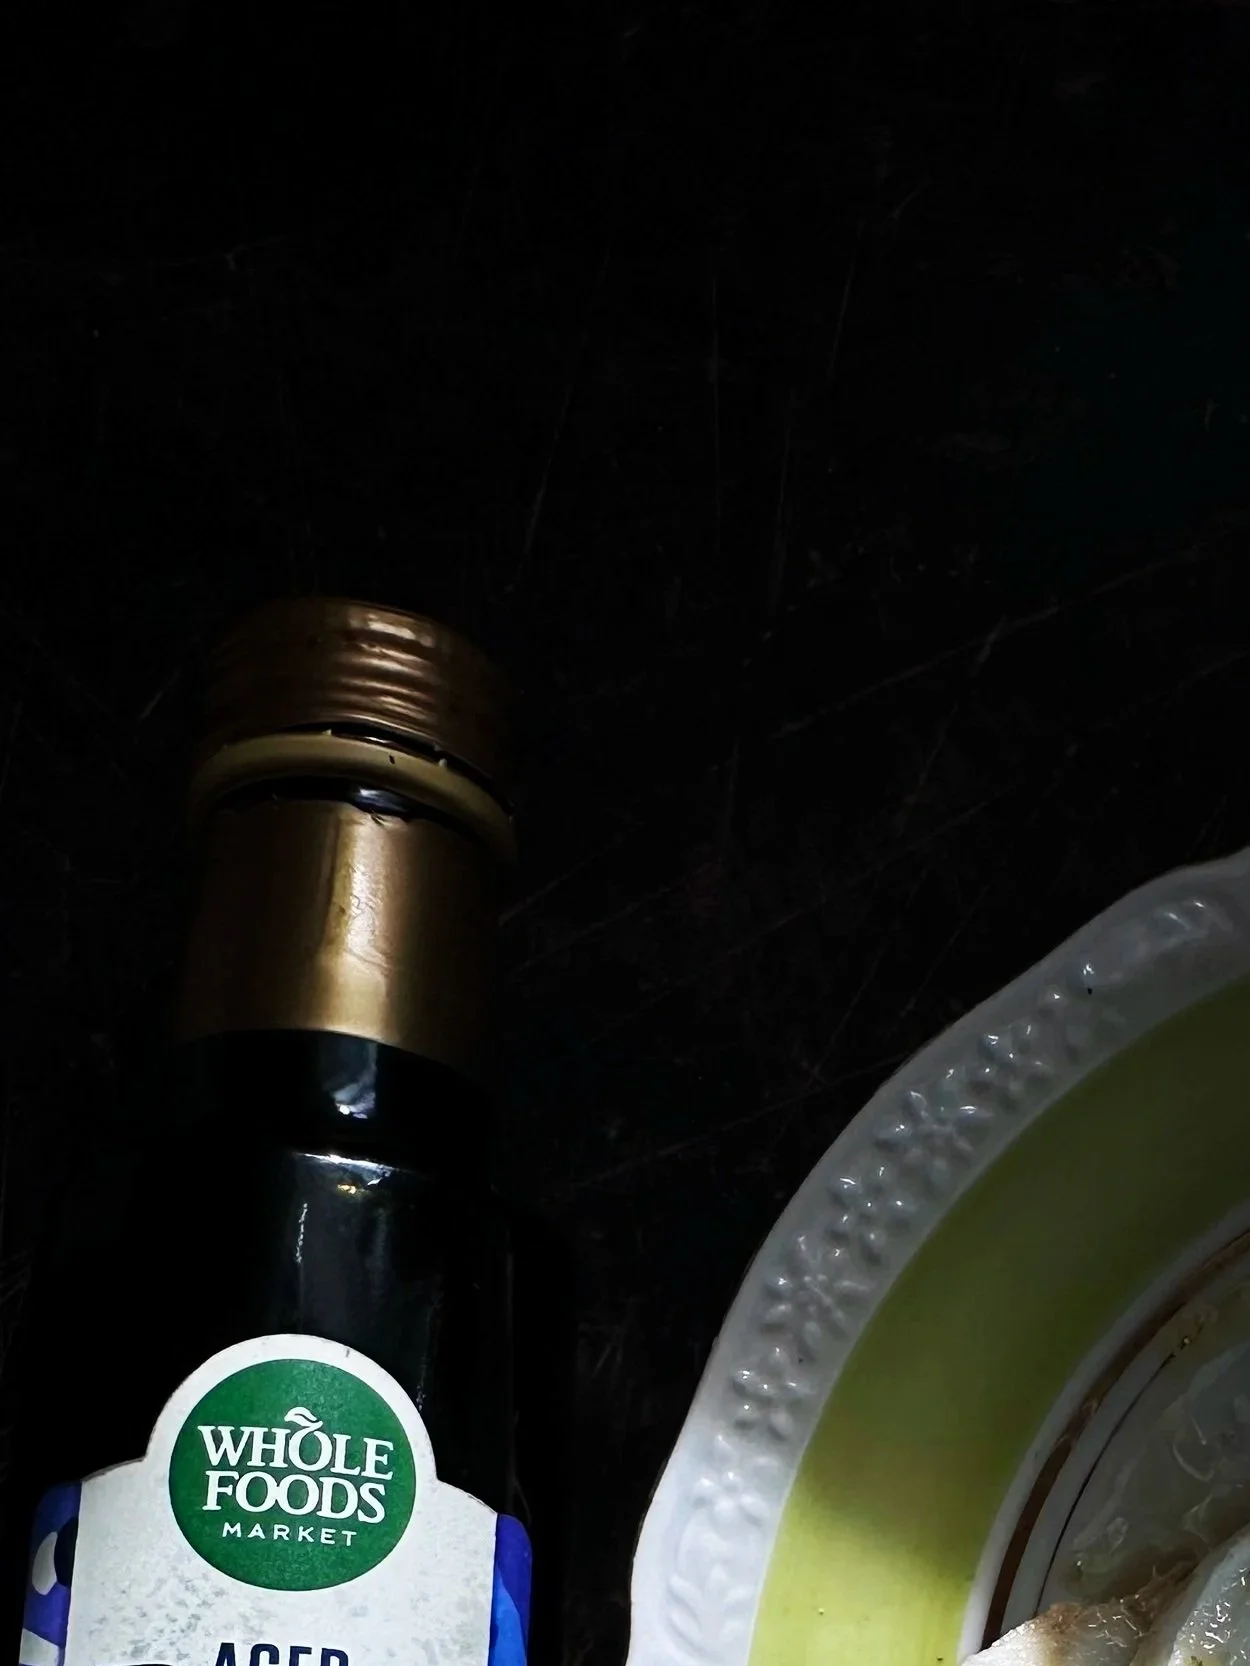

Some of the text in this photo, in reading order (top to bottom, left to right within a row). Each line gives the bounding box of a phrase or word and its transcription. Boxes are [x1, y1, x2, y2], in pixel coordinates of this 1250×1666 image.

[197, 1421, 394, 1481] WHOLE
[202, 1470, 386, 1524] FOODS
[222, 1521, 357, 1547] MARKET
